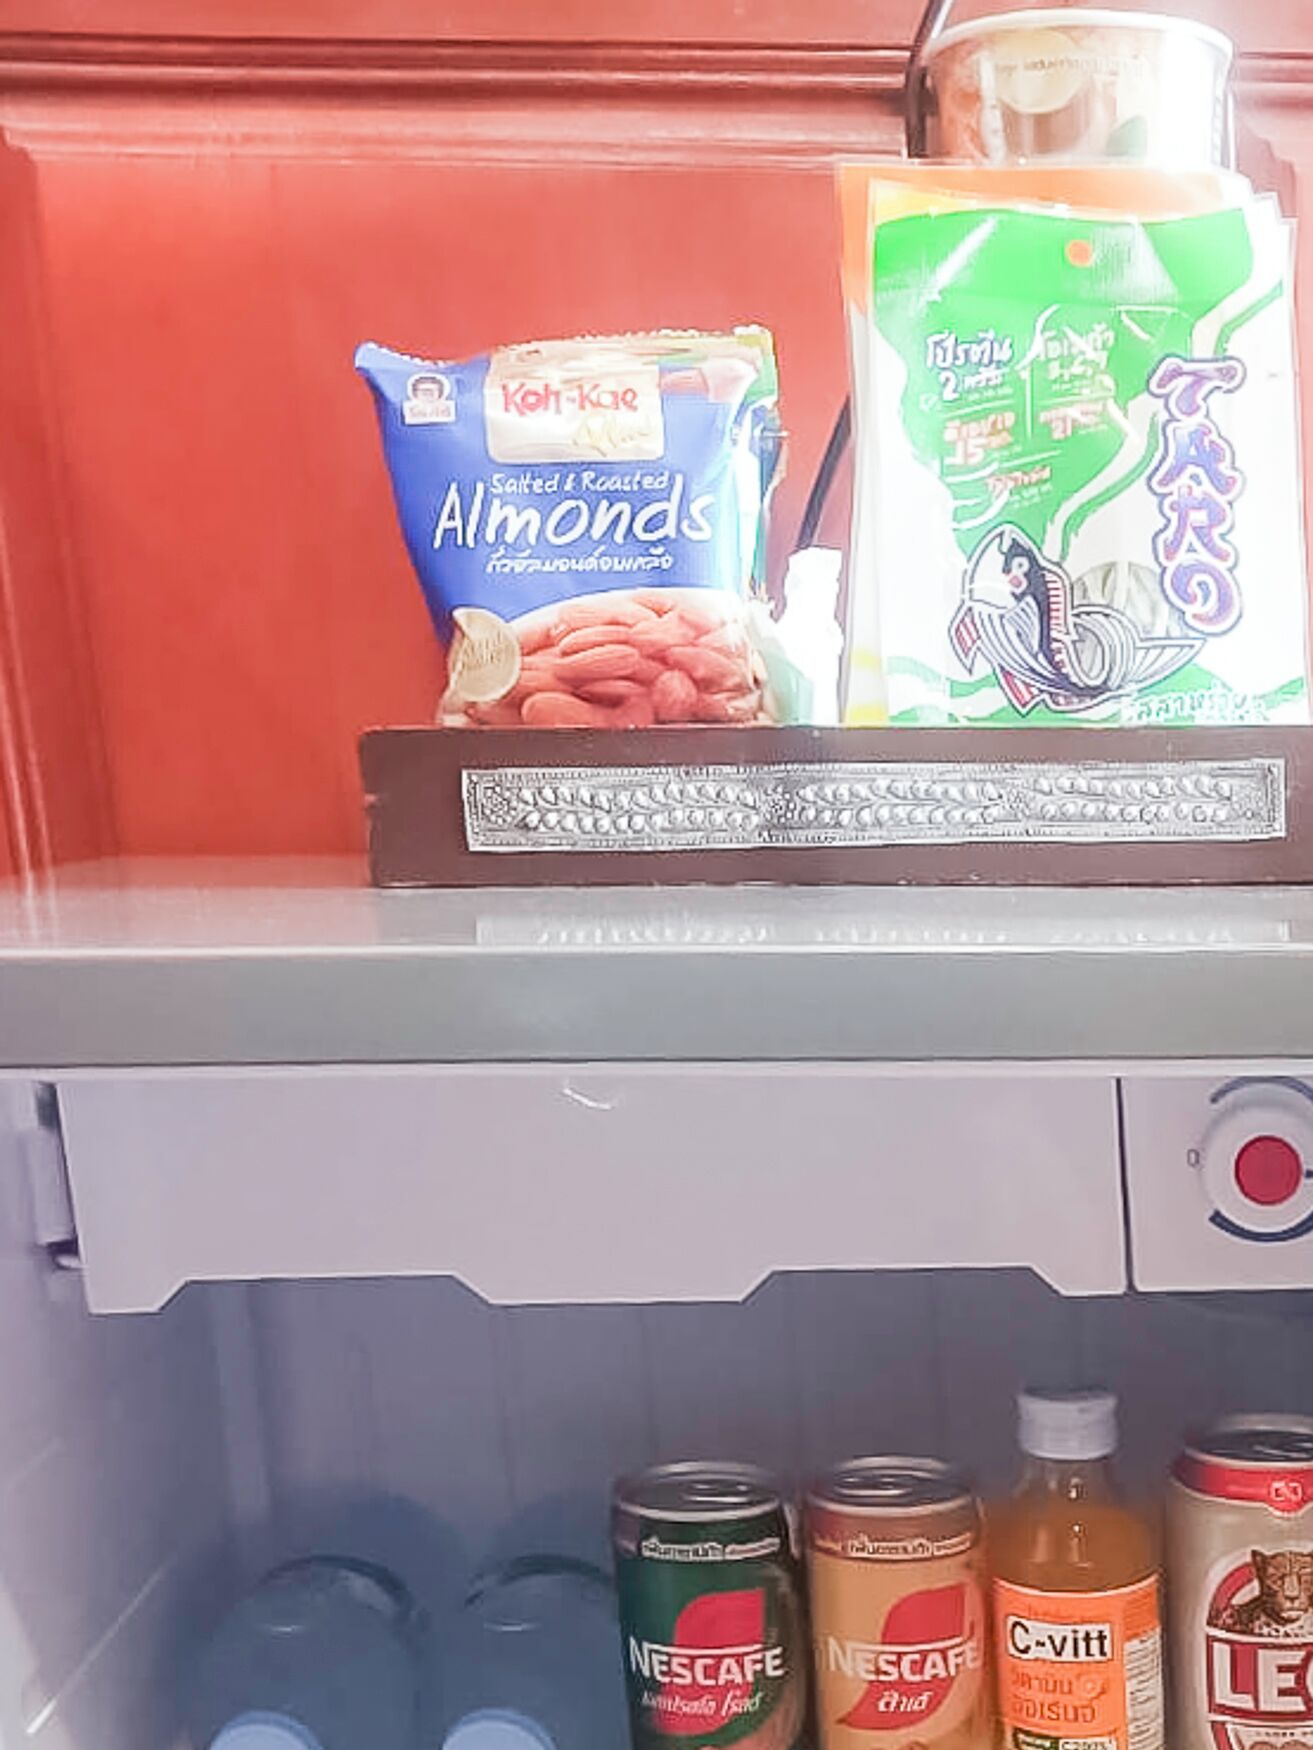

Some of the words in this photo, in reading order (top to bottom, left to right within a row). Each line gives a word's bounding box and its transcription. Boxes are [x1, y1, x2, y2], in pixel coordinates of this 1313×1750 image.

[502, 382, 639, 417] Koh-Kae
[490, 473, 558, 495] Salted
[581, 471, 669, 492] Roasted
[433, 474, 716, 549] Almonds
[1011, 1620, 1107, 1658] C-vitt
